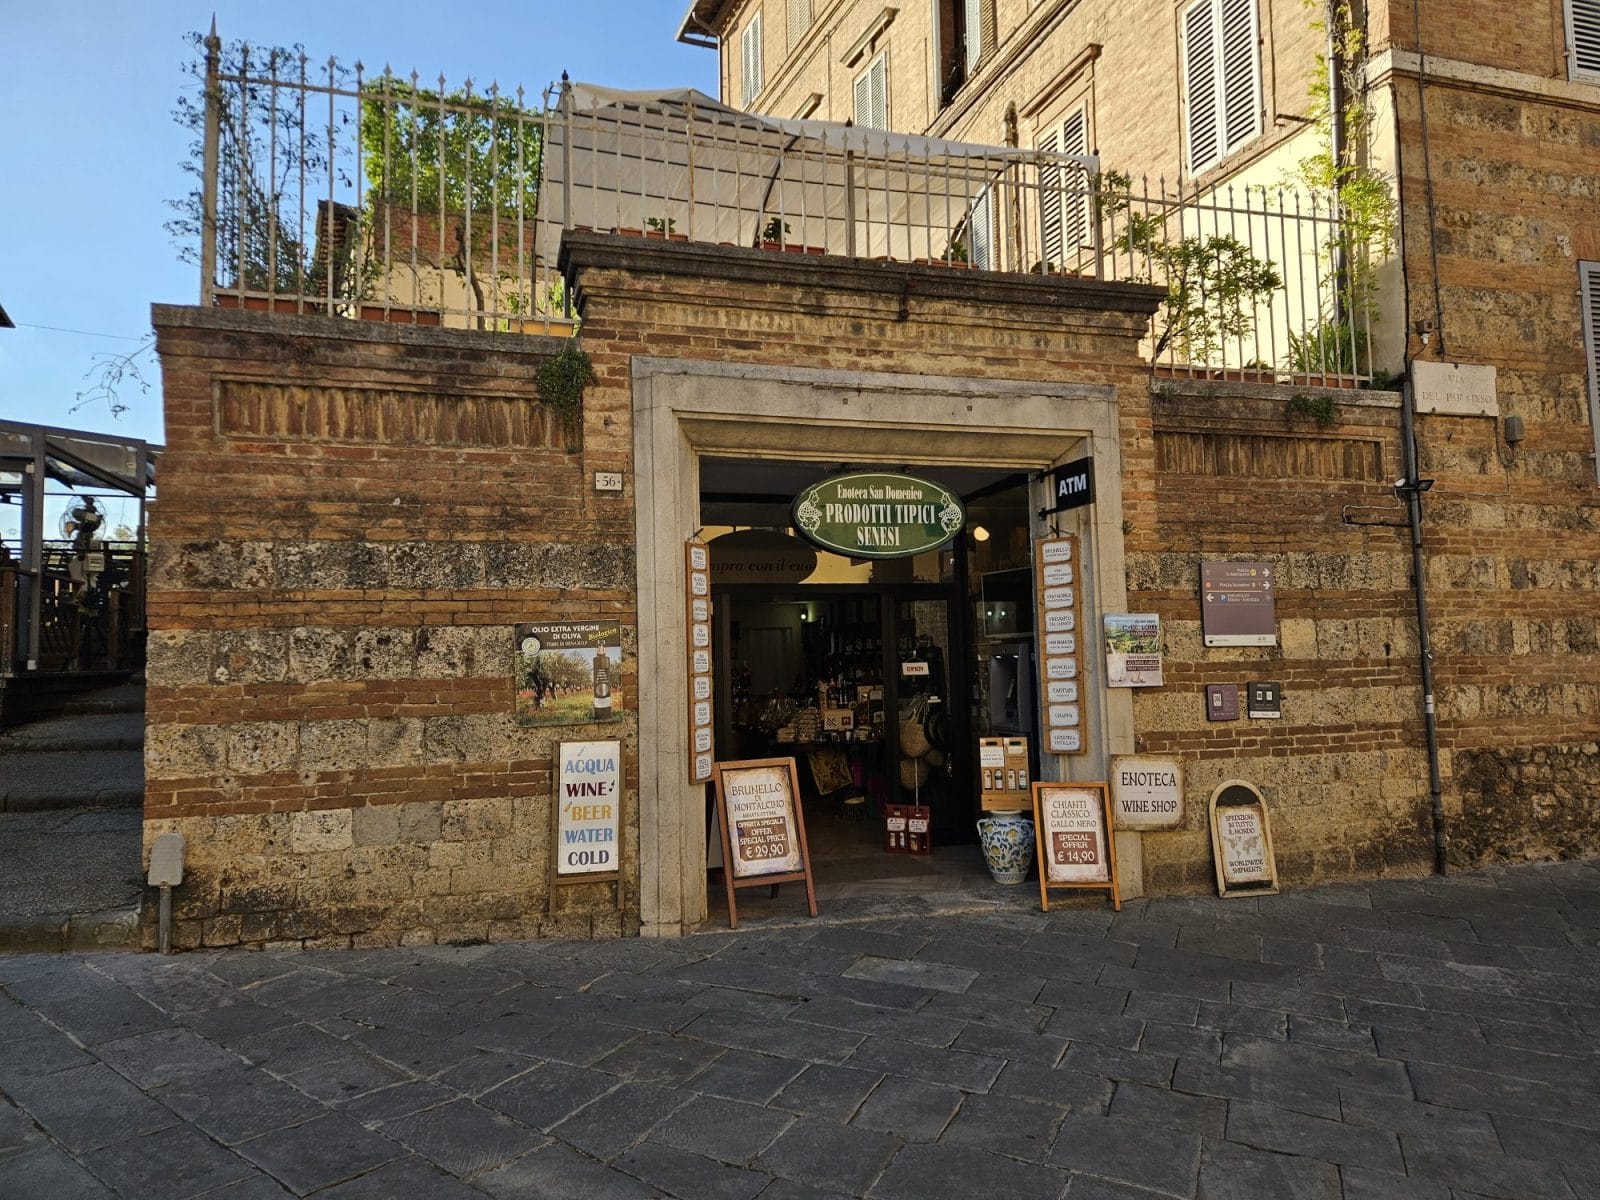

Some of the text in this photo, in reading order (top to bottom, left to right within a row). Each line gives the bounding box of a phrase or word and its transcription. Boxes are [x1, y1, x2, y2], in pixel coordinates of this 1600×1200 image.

[1448, 374, 1464, 384] VIA
[1422, 391, 1440, 401] DEL
[602, 475, 616, 487] 56
[1058, 473, 1086, 497] ATM
[837, 484, 922, 500] Enoteca San Domenico
[825, 503, 936, 524] PRODOTTI TIPICI
[857, 526, 901, 546] SENESI
[748, 561, 772, 572] con
[776, 557, 786, 572] il
[550, 625, 571, 633] EXTRA
[572, 624, 600, 632] VERGINE
[561, 632, 582, 640] OLIVA
[564, 758, 615, 775] ACQUA
[1121, 772, 1177, 787] ENOTECA
[566, 781, 608, 798] WINE
[731, 782, 783, 797] BRUNELLO
[754, 794, 762, 802] DI
[1052, 800, 1087, 809] CHIANTI
[733, 799, 785, 812] MONTALCINO
[1122, 800, 1178, 813] WINE SHOP
[571, 804, 612, 821] BEER
[1050, 810, 1091, 819] CLASSICO
[737, 818, 784, 829] OFFERTA SPECIALE
[1050, 820, 1097, 829] GALLO NERO
[565, 828, 613, 844] WATER
[750, 827, 773, 837] OFFER
[1058, 833, 1091, 841] SPECIAL
[738, 833, 786, 846] SPECIAL PRICE
[746, 843, 785, 859] € 29,90
[1057, 850, 1095, 864] € 14,90
[567, 849, 610, 867] COLD
[1228, 858, 1264, 867] WORLDWIDE
[1232, 866, 1263, 875] SHIPMENTS
